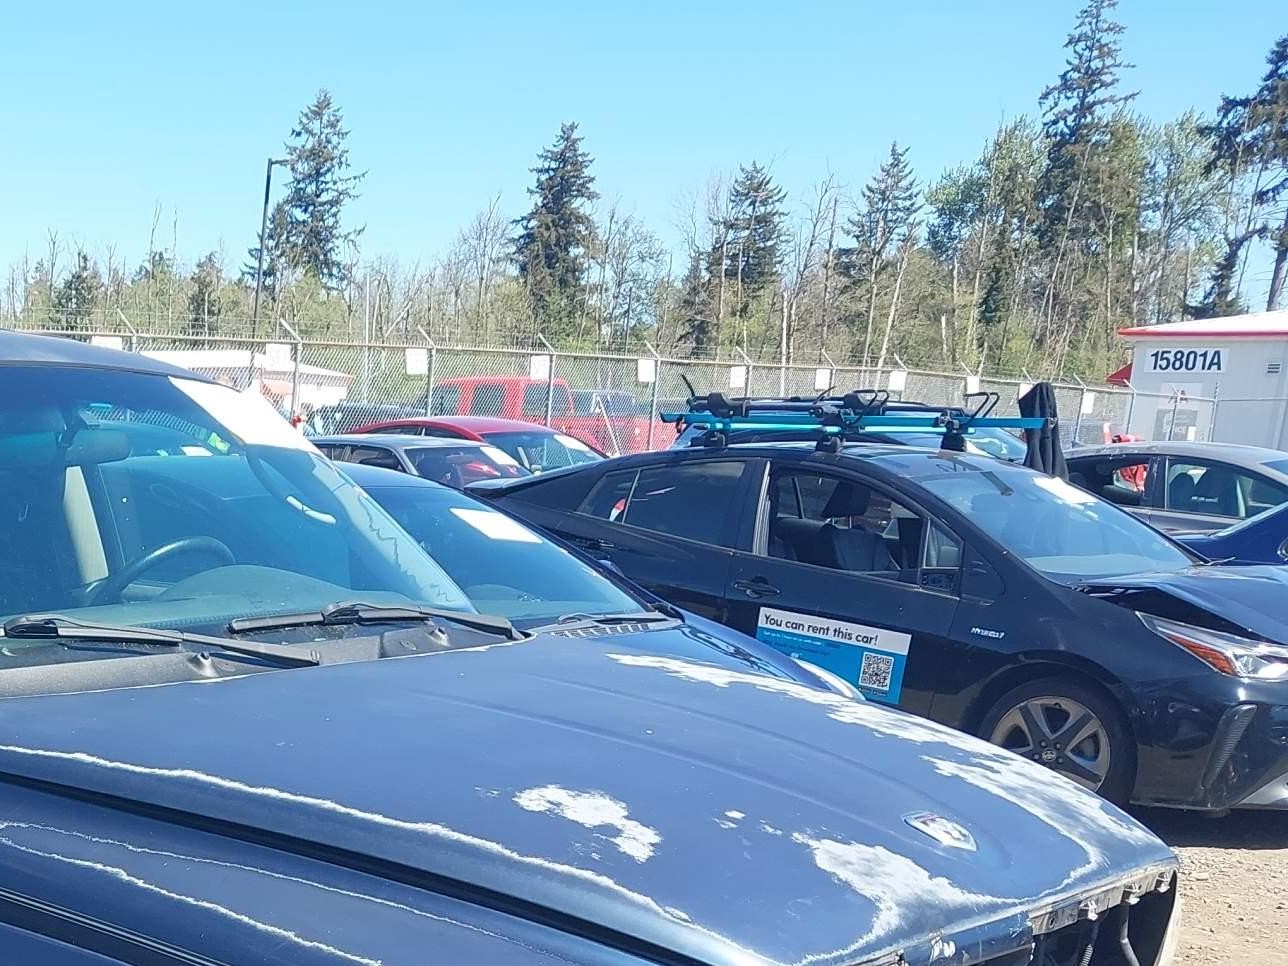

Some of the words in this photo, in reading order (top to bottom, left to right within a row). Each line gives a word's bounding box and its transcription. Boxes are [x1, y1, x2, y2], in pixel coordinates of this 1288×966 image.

[1150, 349, 1222, 371] 15801A
[764, 613, 782, 627] You
[784, 620, 805, 632] can
[807, 624, 830, 636] rent
[832, 627, 853, 641] this
[855, 633, 879, 646] car!
